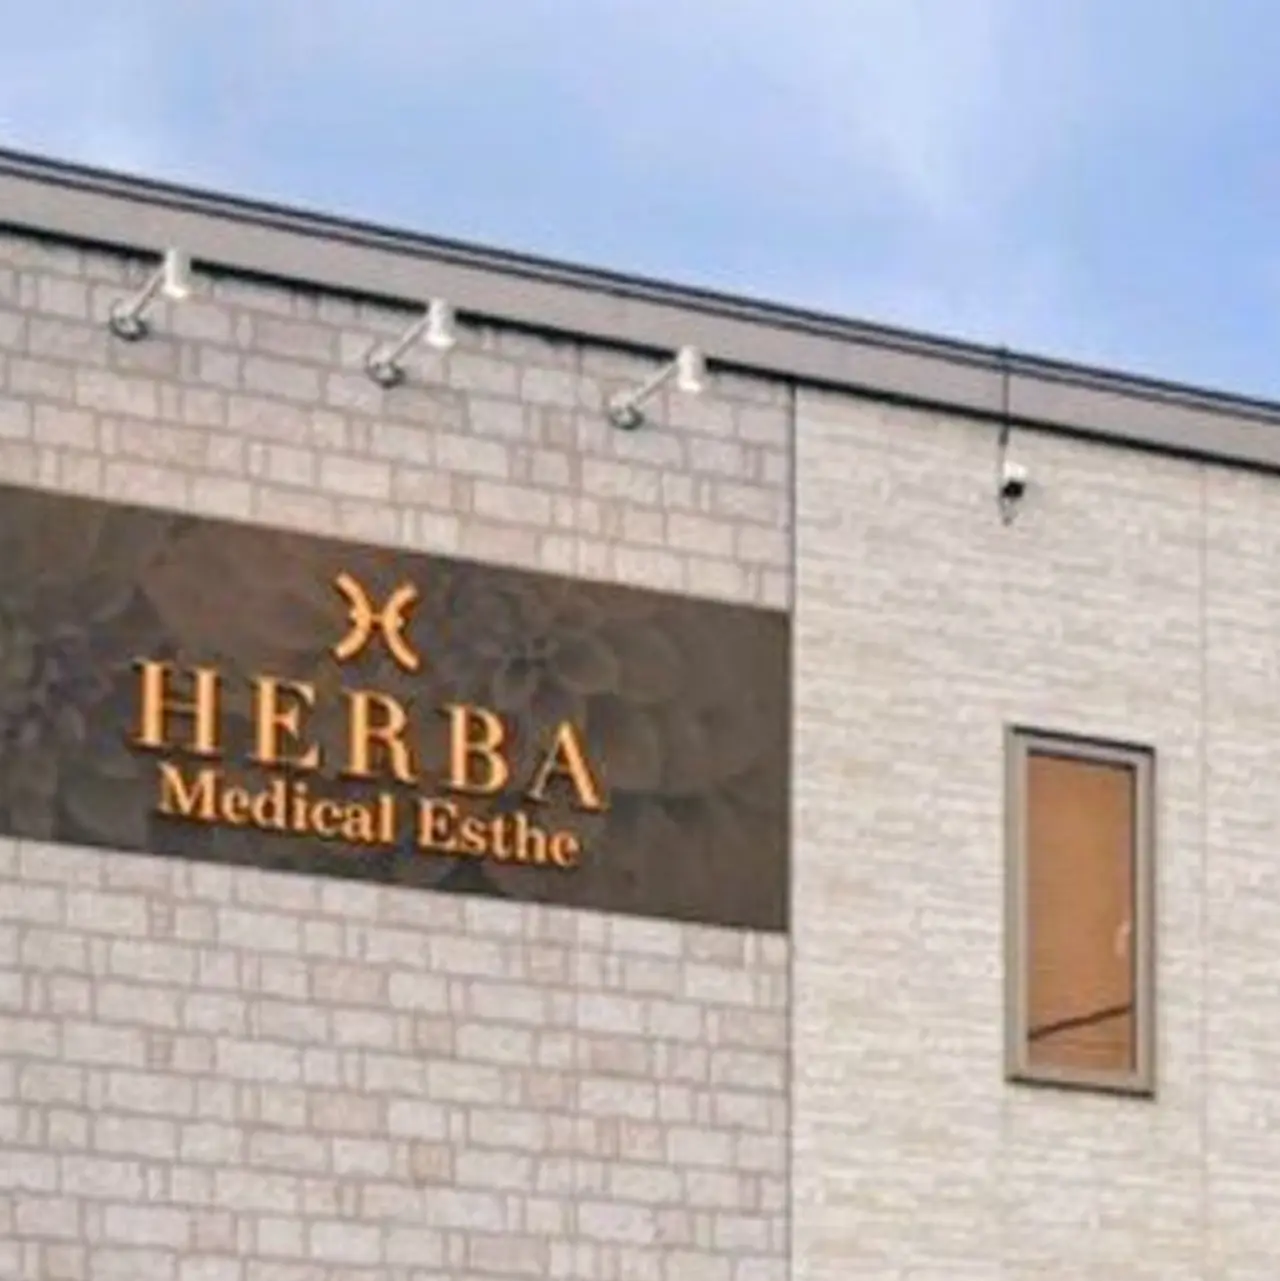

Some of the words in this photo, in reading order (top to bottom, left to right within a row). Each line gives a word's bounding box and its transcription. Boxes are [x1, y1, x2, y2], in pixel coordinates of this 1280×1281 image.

[132, 657, 607, 811] HERBA
[158, 763, 396, 845] Medical
[419, 798, 581, 867] Esthe
